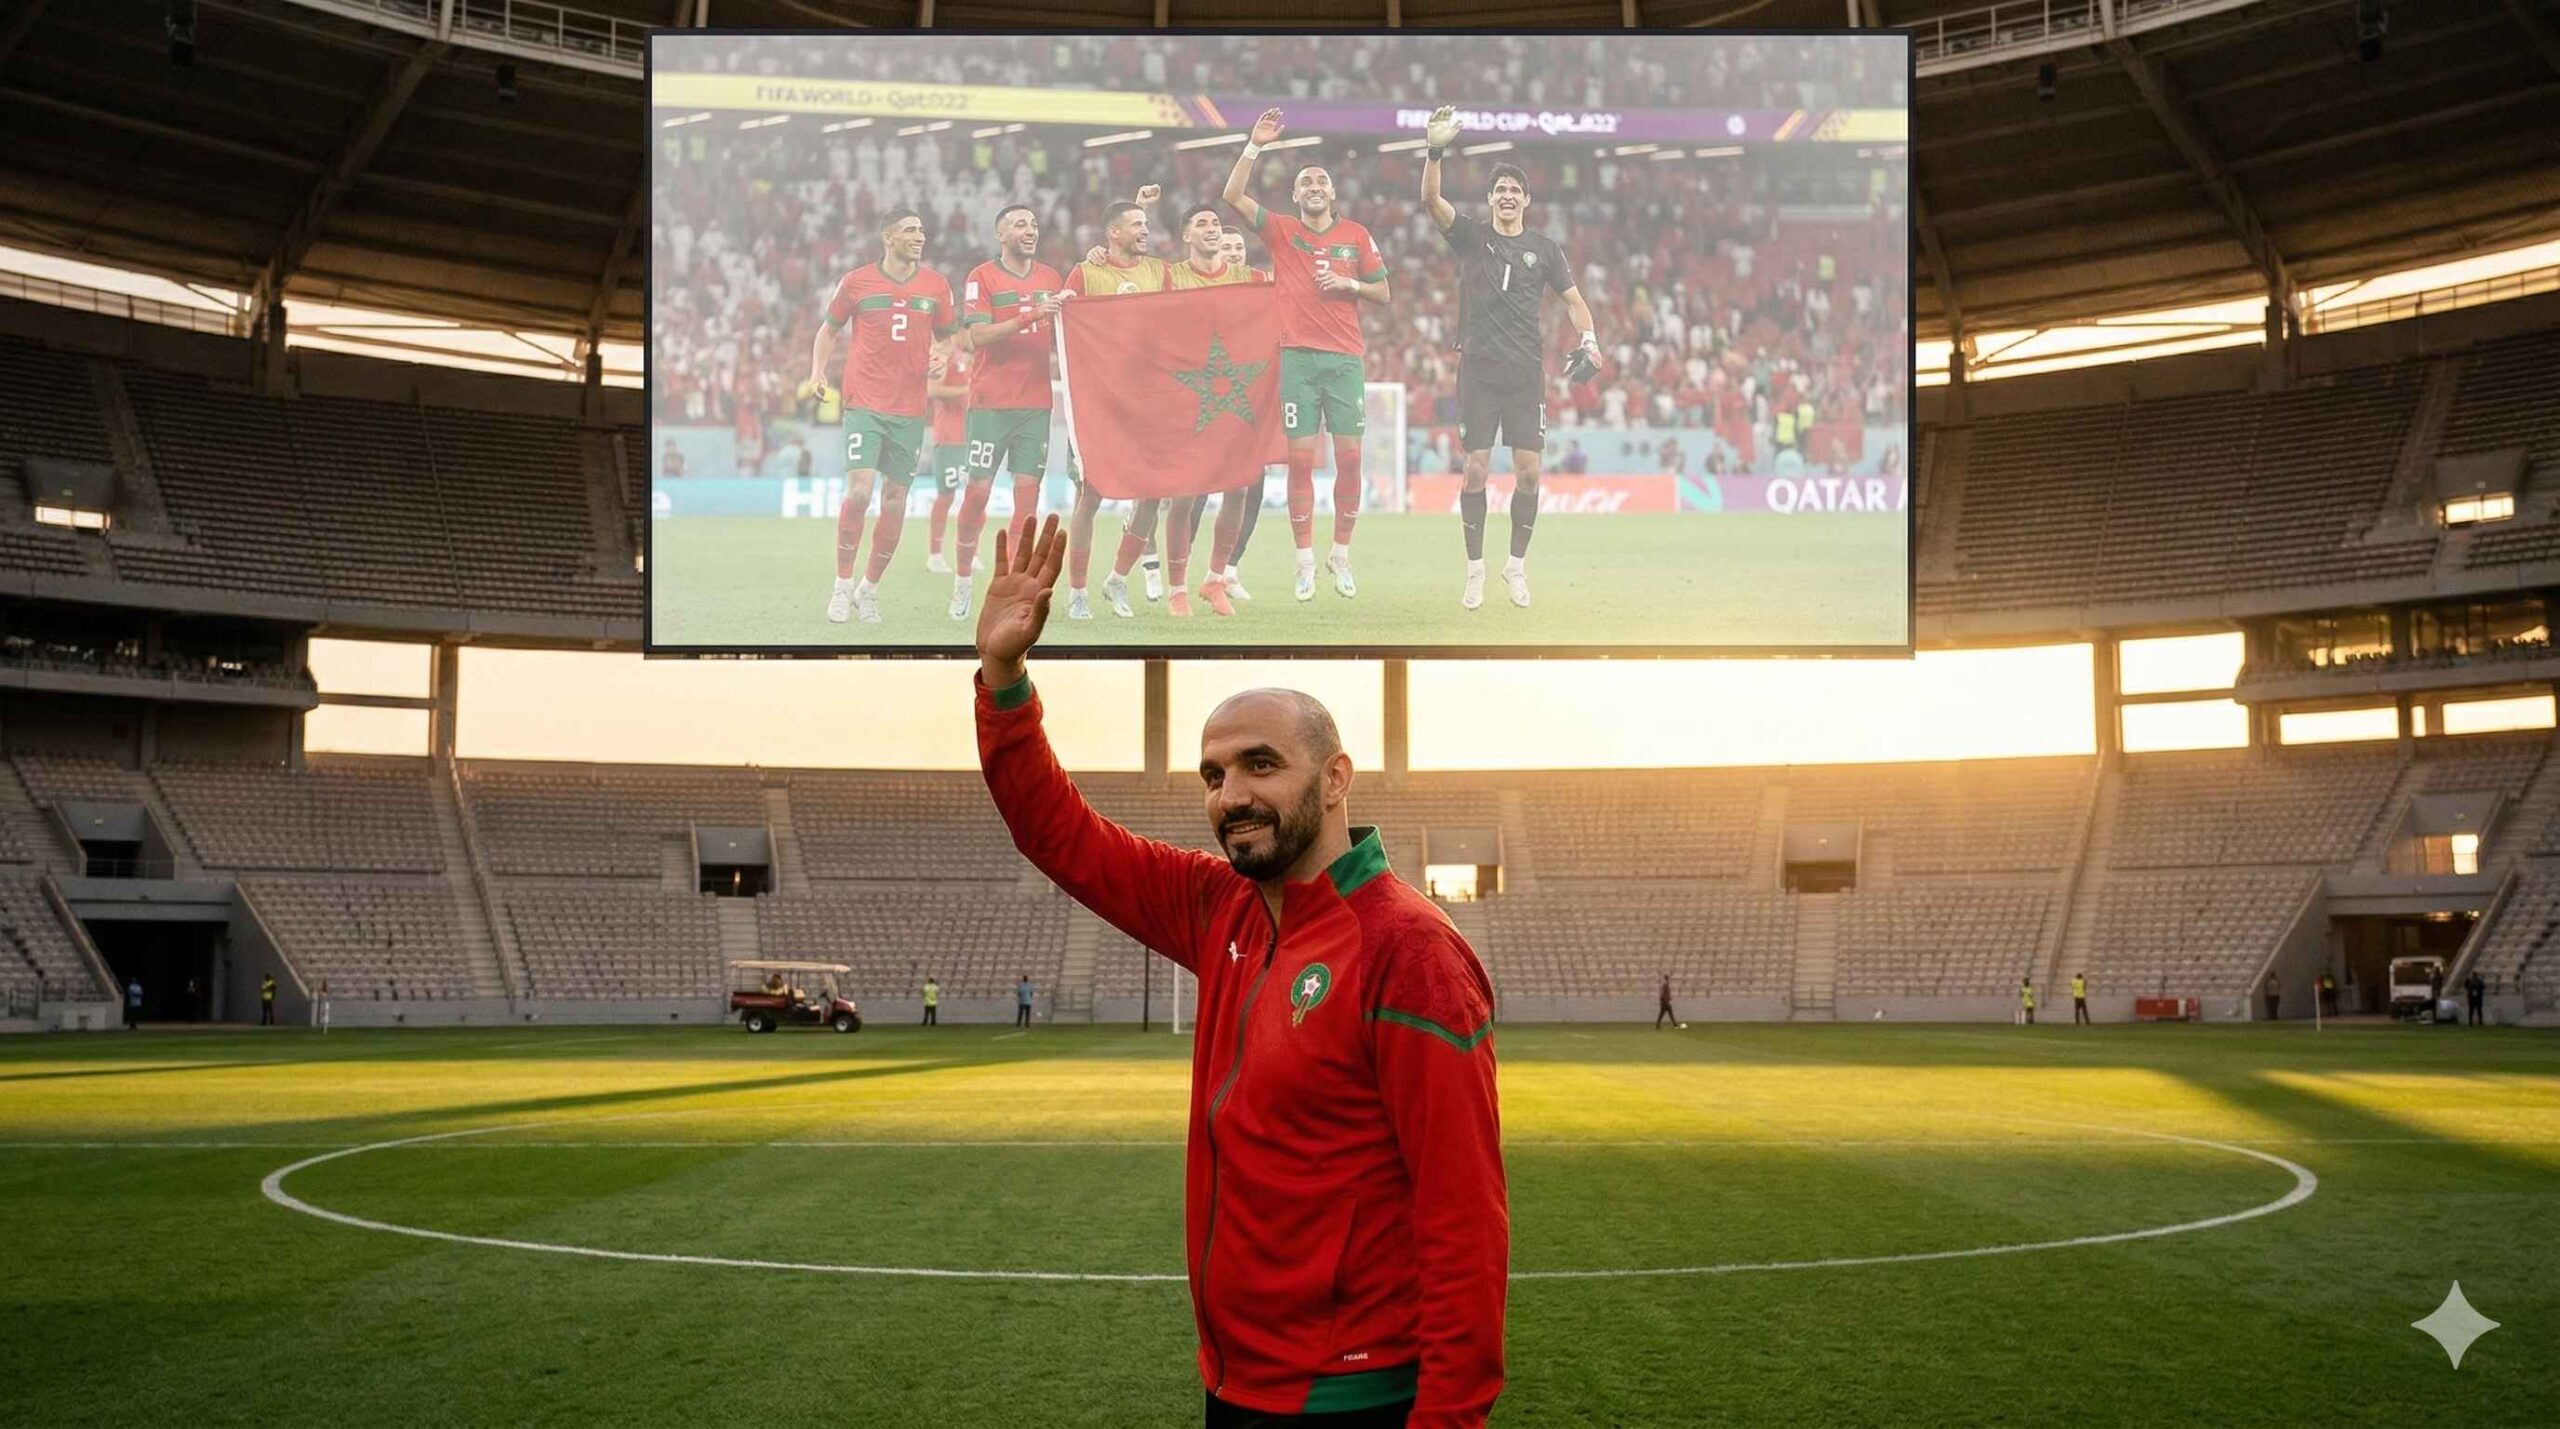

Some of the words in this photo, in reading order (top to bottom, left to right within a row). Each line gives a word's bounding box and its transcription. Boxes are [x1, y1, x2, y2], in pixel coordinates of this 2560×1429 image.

[891, 314, 908, 341] 2
[848, 433, 863, 460] 2
[969, 440, 995, 468] 28
[1766, 478, 1887, 514] QATAR
